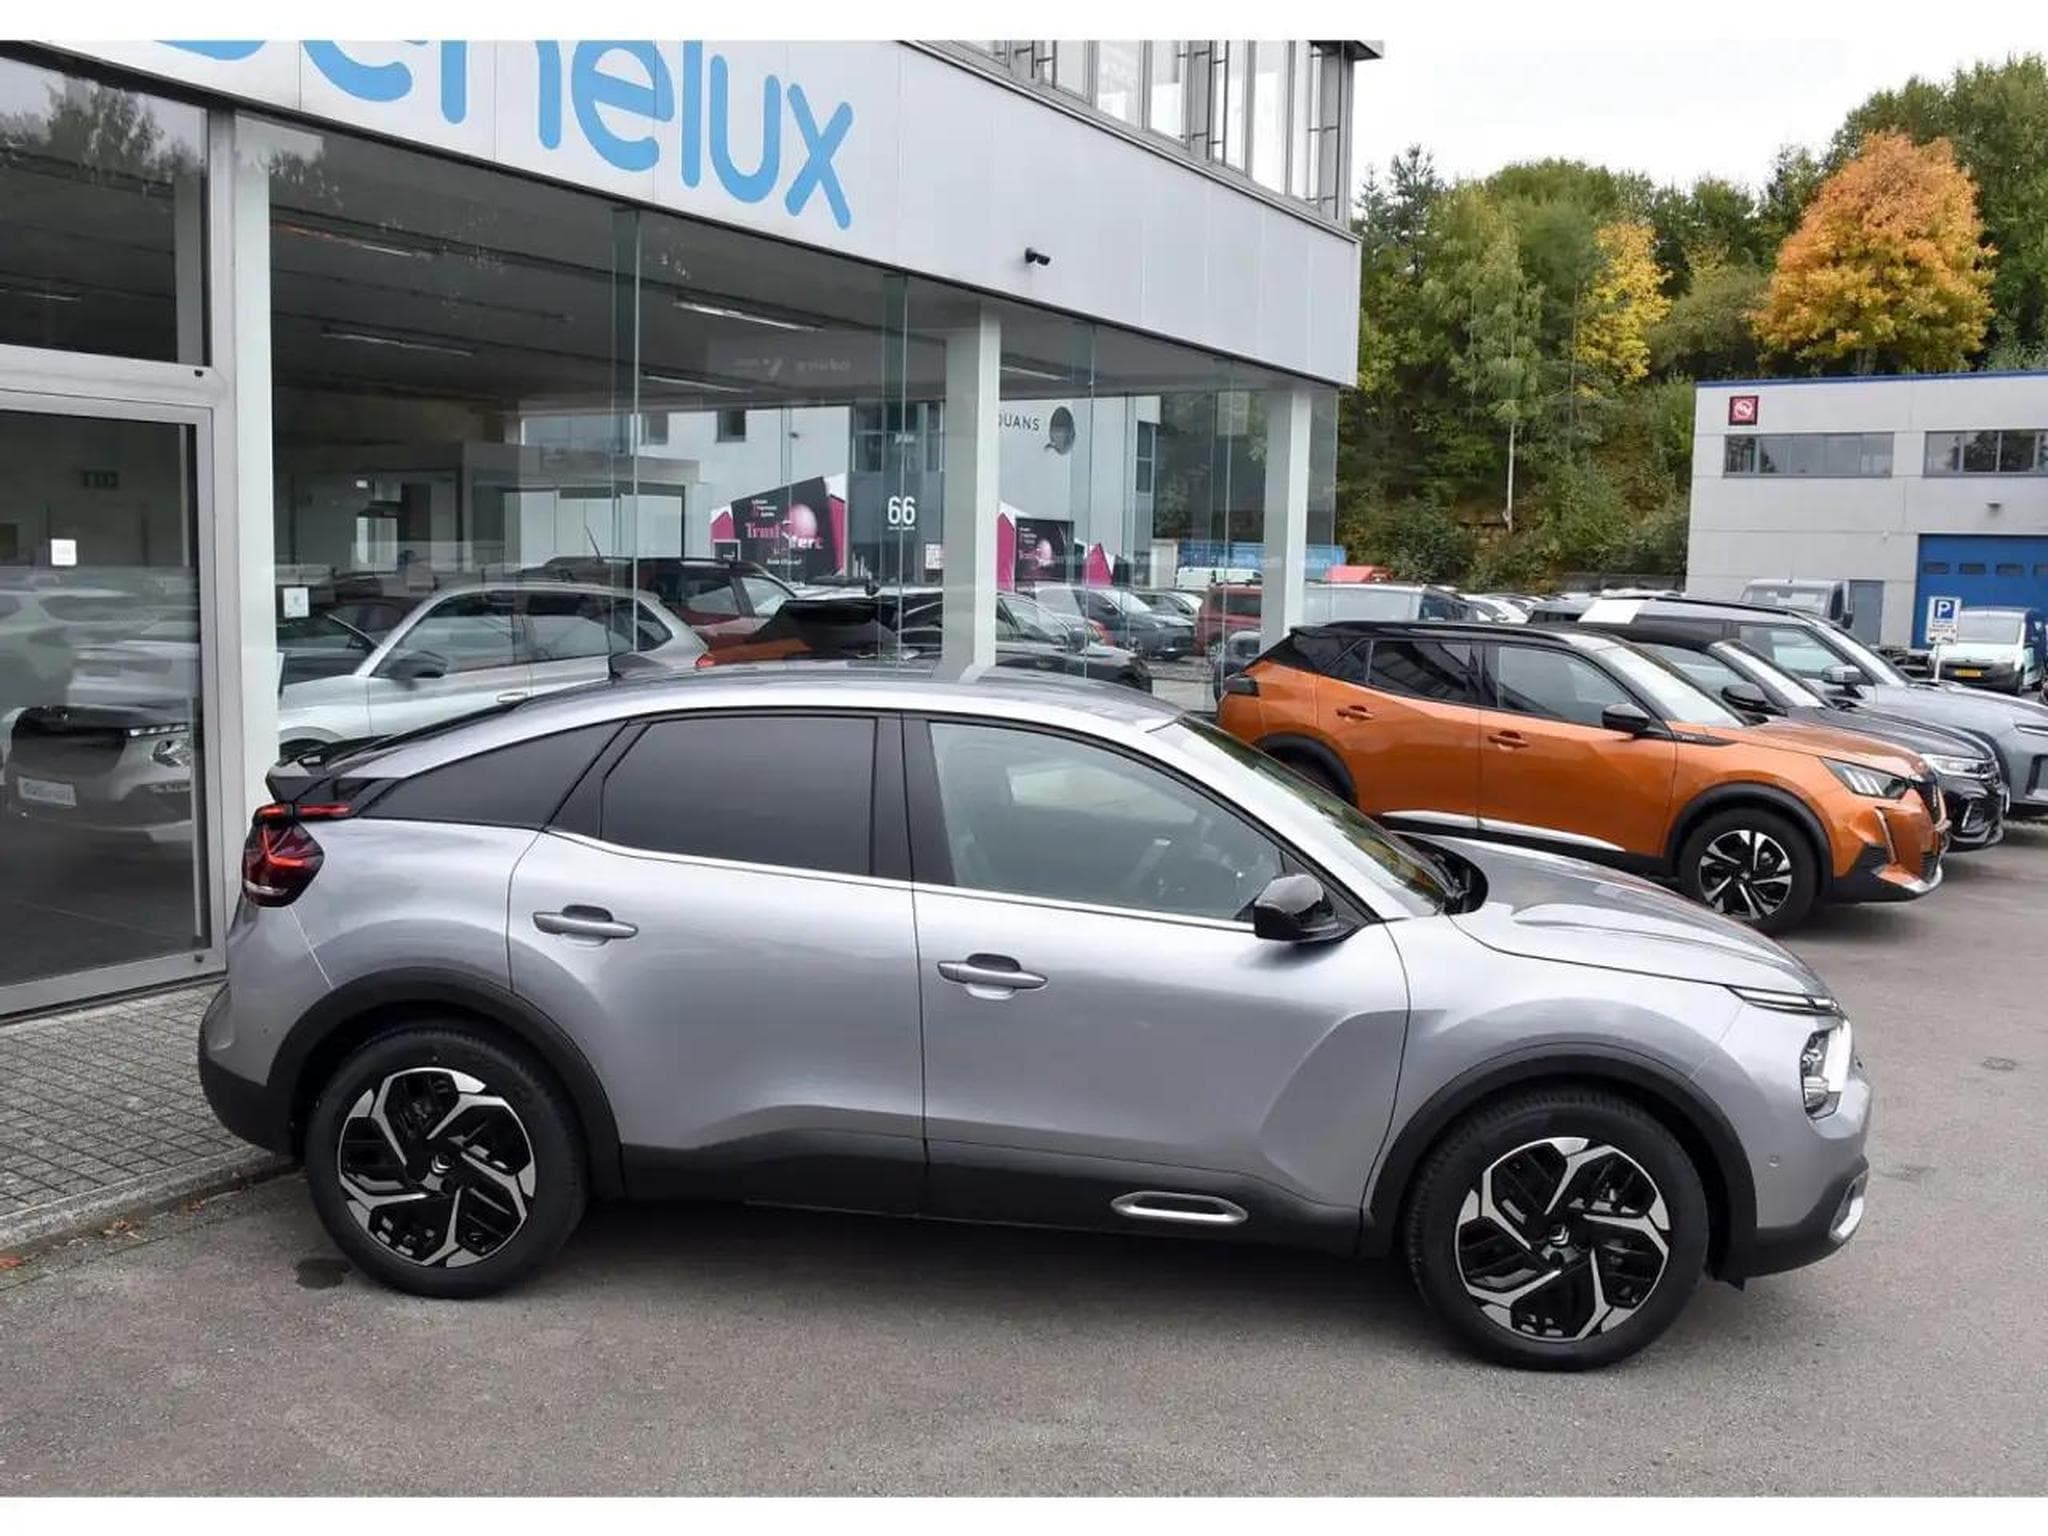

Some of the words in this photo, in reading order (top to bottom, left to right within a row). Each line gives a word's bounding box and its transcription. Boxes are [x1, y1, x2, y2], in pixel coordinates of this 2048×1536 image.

[152, 40, 853, 229] nelux
[887, 495, 916, 525] 66
[1937, 601, 1952, 619] P
